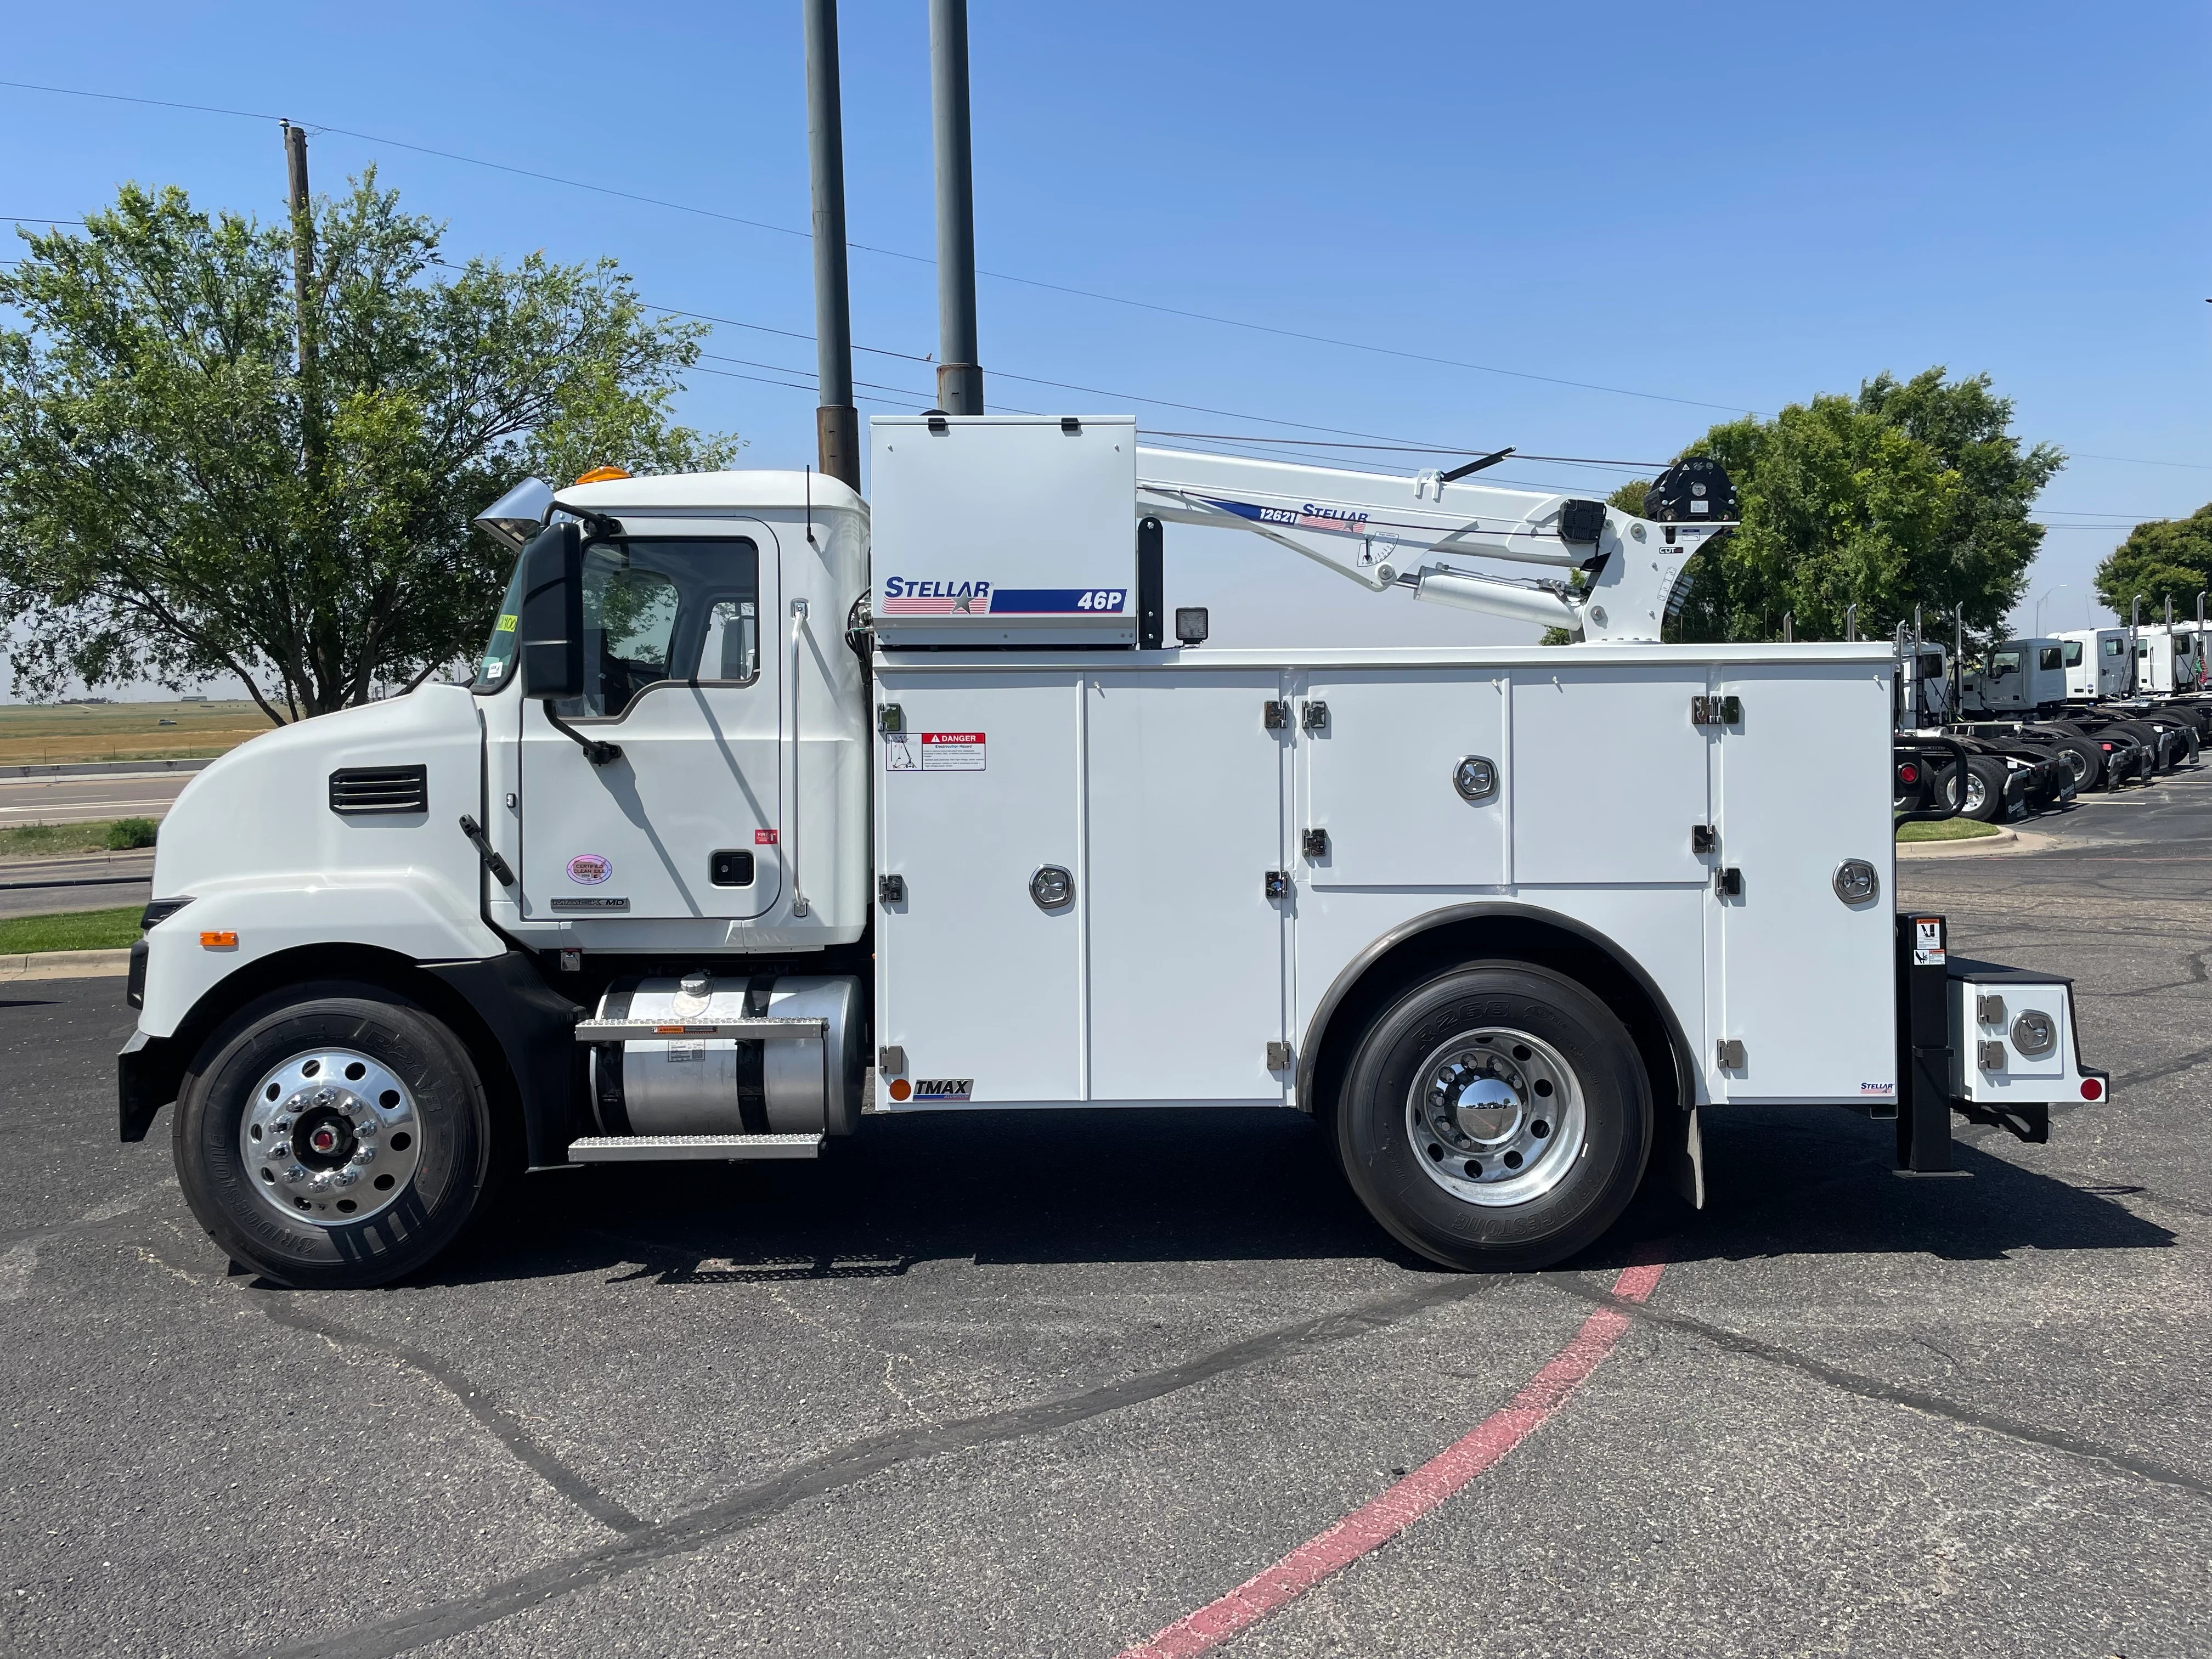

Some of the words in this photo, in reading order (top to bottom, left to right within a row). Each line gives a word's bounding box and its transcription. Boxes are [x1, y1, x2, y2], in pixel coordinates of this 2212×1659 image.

[1260, 509, 1296, 523] 12621
[1302, 503, 1368, 522] STELLAR
[884, 576, 990, 598] STELLAR
[1077, 591, 1122, 610] 46P
[1411, 1000, 1510, 1051] R268
[916, 1080, 969, 1094] TMAX
[207, 1132, 321, 1257] BRIDGESTONE
[1451, 1162, 1604, 1238] BRIDGESTONE
